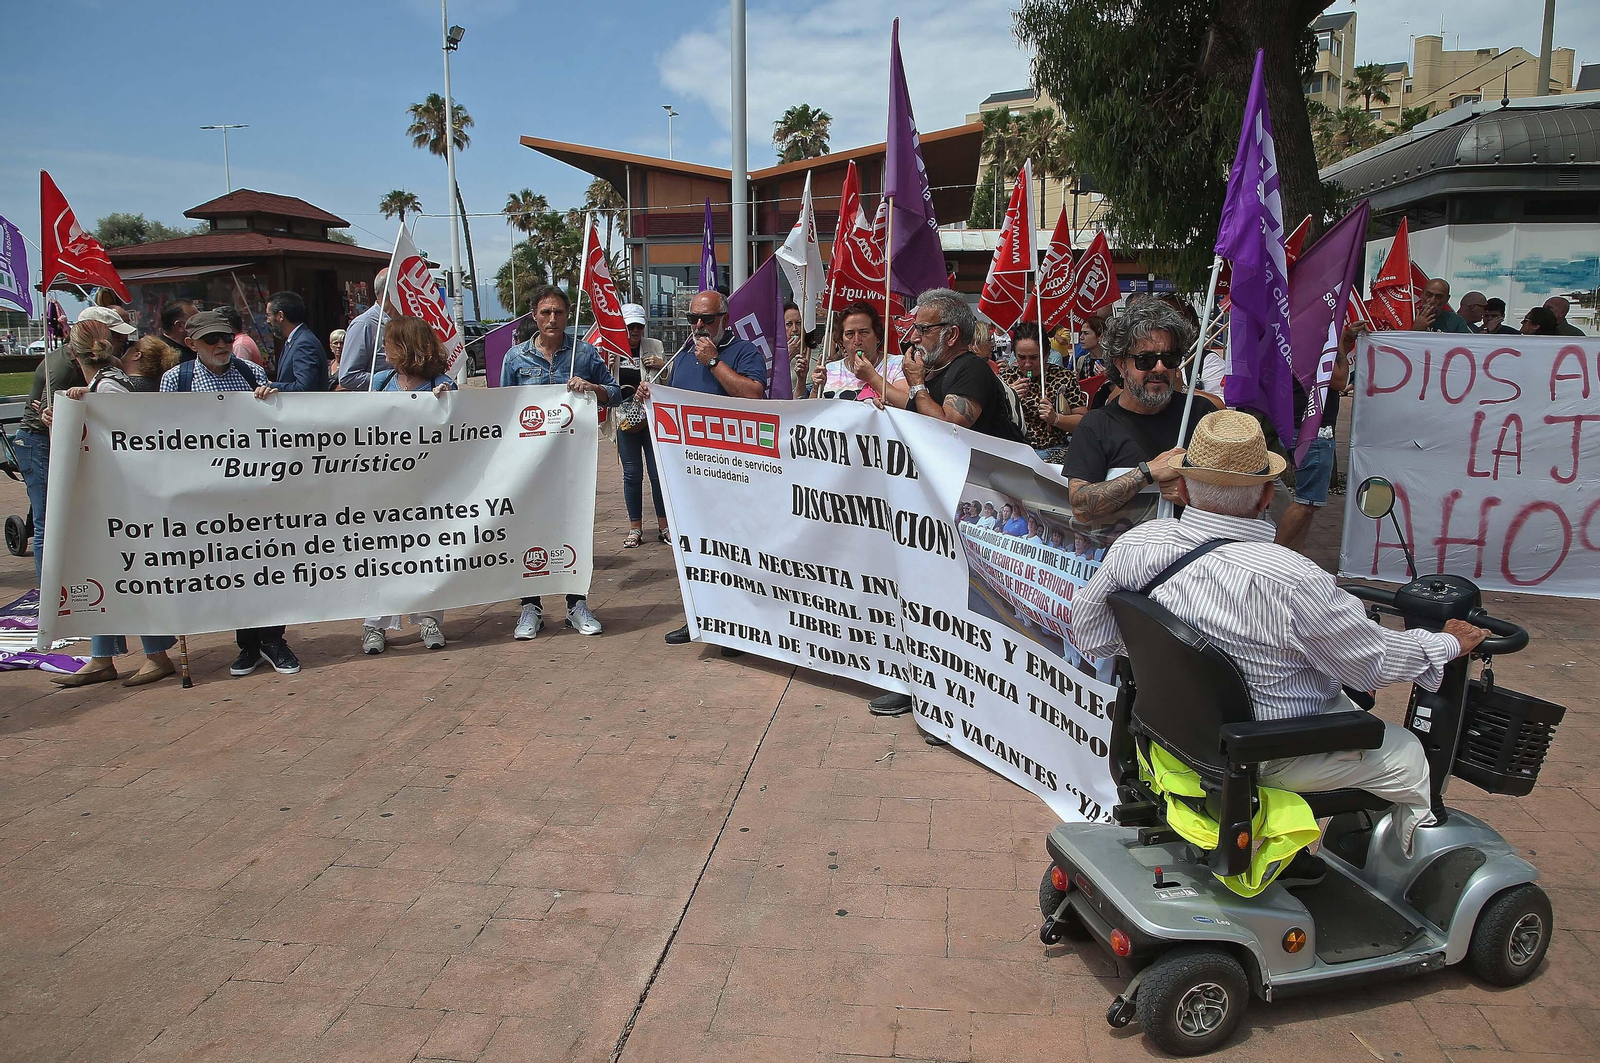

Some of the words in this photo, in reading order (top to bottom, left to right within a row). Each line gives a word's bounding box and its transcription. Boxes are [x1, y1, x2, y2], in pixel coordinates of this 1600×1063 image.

[1366, 345, 1522, 405] DIOS
[1550, 344, 1600, 401] A
[523, 409, 543, 420] UGT
[687, 414, 758, 446] CCOO
[111, 429, 250, 451] Residencia
[256, 428, 347, 451] Tiempo
[354, 426, 412, 446] Libre
[419, 426, 442, 444] La
[449, 423, 503, 443] Línea
[789, 424, 852, 467] ¡BASTA
[856, 434, 883, 470] YA
[1467, 410, 1523, 481] LA
[1544, 414, 1600, 484] J
[685, 449, 730, 465] federación
[732, 456, 742, 467] de
[744, 459, 783, 475] servicios
[693, 465, 701, 475] la
[703, 466, 750, 483] ciudadanía
[108, 517, 154, 539] Por
[162, 517, 187, 538] la
[196, 513, 327, 535] cobertura
[335, 507, 366, 525] de
[373, 502, 479, 523] vacantes
[485, 498, 515, 516] YA
[792, 484, 956, 560] DISCRIMINCION!
[121, 551, 136, 571] y
[144, 538, 296, 569] ampliación
[304, 535, 336, 554] de
[342, 532, 431, 553] tiempo
[438, 529, 466, 546] en
[474, 525, 507, 544] los
[526, 551, 546, 561] UGT
[1009, 538, 1037, 559] TIEMPO
[1037, 548, 1058, 568] LIBRE
[1060, 555, 1070, 571] DE
[1071, 559, 1081, 578] LA
[115, 573, 245, 595] contratos
[253, 566, 286, 586] de
[293, 563, 347, 587] fijos
[354, 552, 516, 578] discontinuos.
[981, 546, 991, 562] LOS
[991, 550, 1023, 576] RECORTES
[1024, 564, 1036, 583] DE
[1038, 567, 1074, 602] SERVICIO
[679, 535, 692, 552] A
[700, 537, 752, 566] LINEA
[758, 552, 854, 590] NECESITA
[1003, 638, 1018, 665] Y
[1014, 579, 1051, 613] DERECHOS
[685, 566, 767, 596] REFORMA
[771, 585, 862, 621] INTEGRAL
[868, 607, 896, 627] DE
[906, 635, 1020, 705] RESIDENCIA
[1027, 692, 1108, 758] TIEMPO
[788, 610, 842, 639] LIBRE
[848, 627, 877, 646] DE
[883, 633, 906, 655] LA
[944, 677, 976, 709] YA!
[778, 634, 801, 653] DE
[806, 642, 871, 671] TODAS
[877, 659, 910, 683] LAS
[960, 718, 1058, 792] VACANTES
